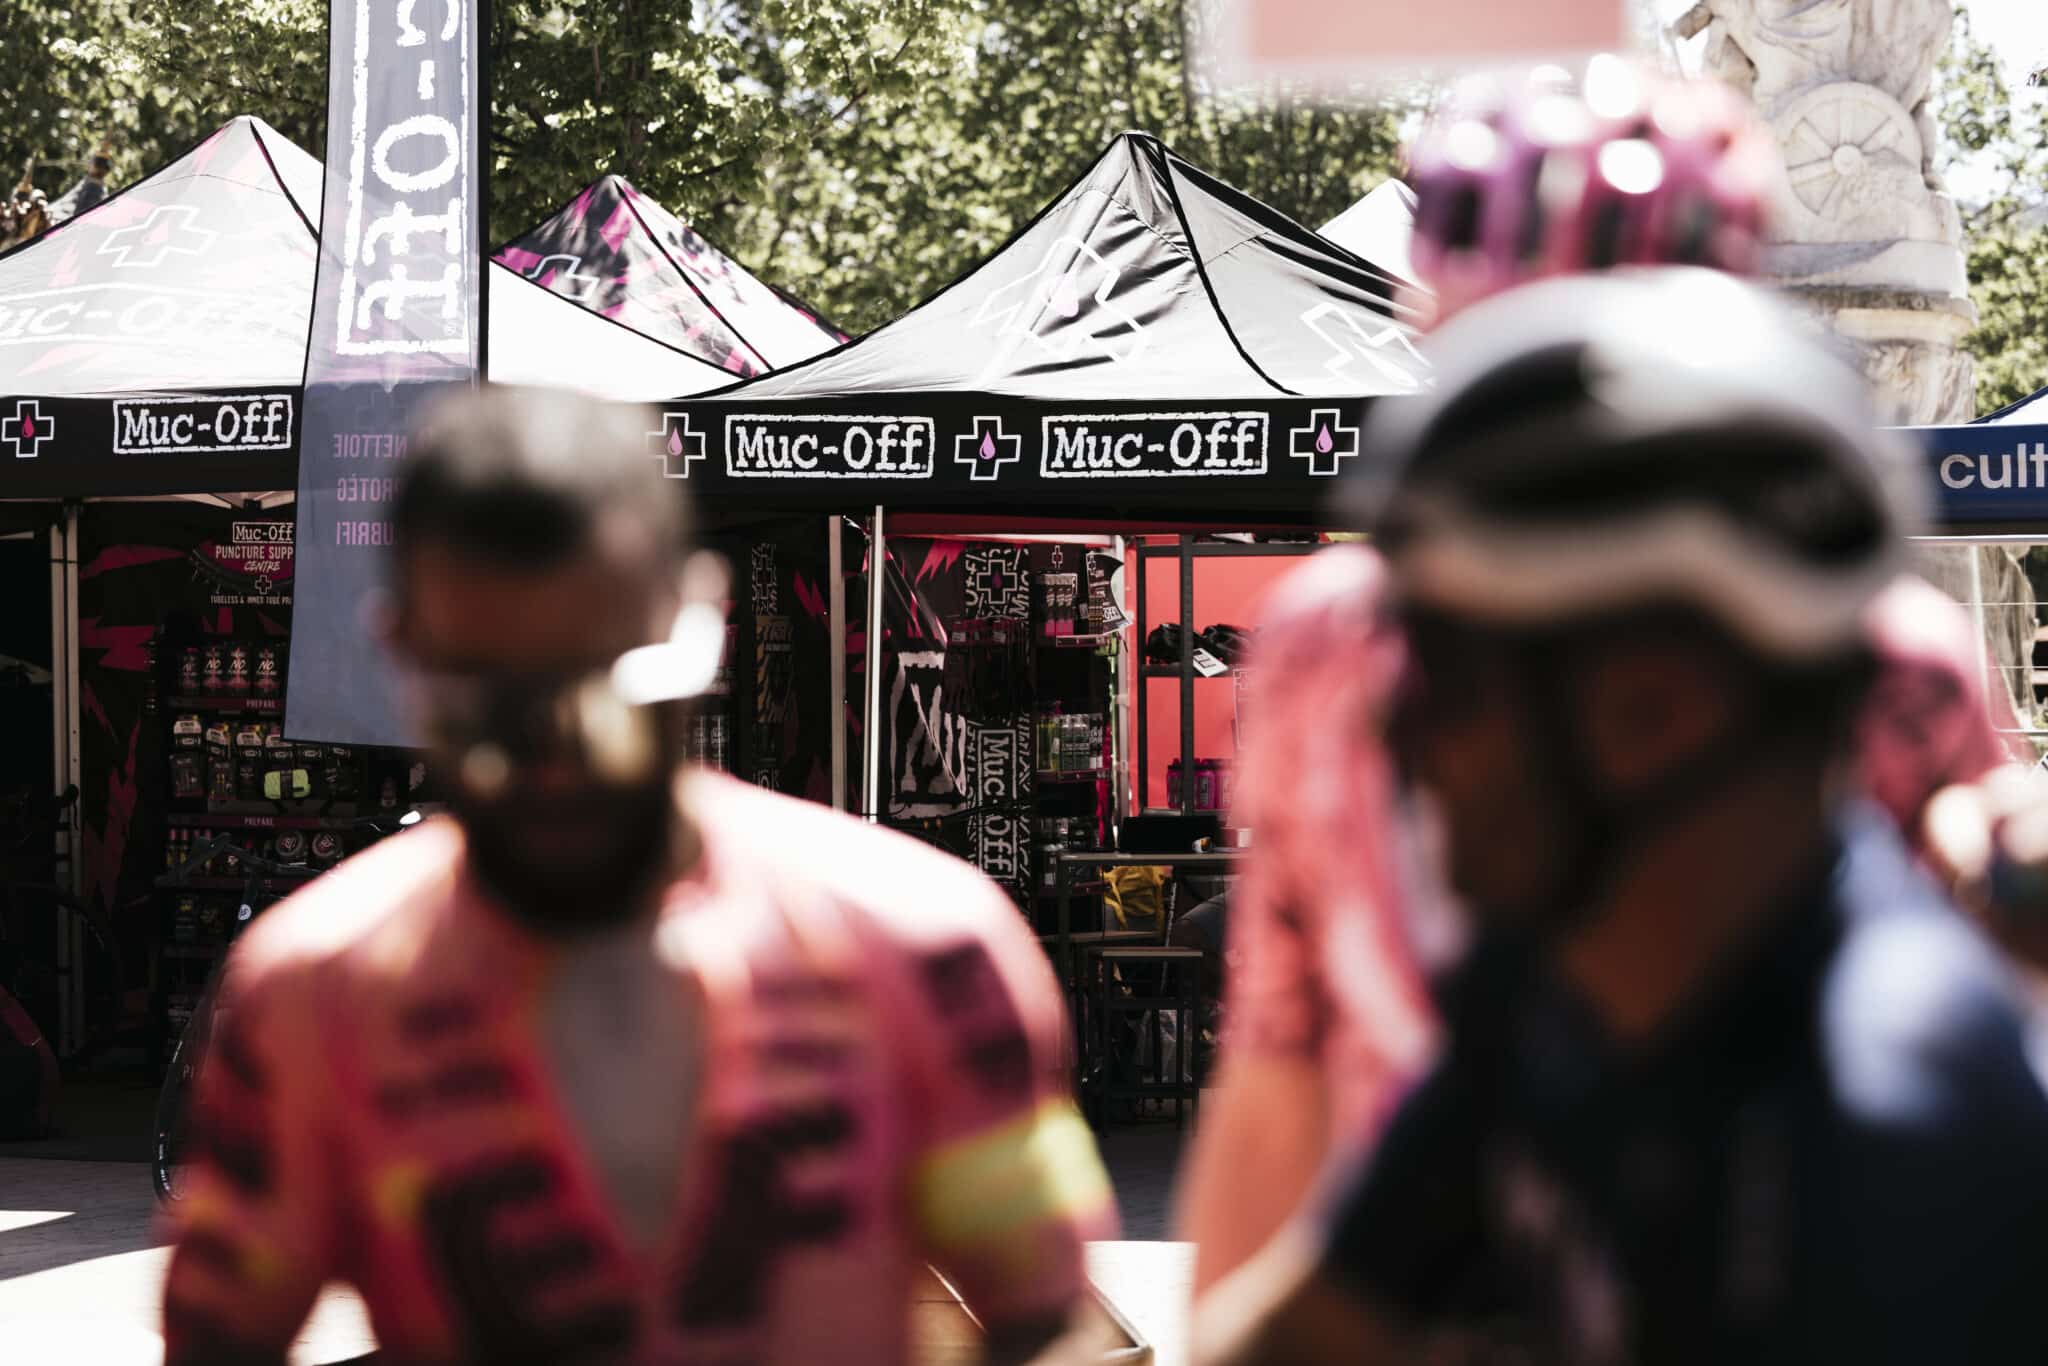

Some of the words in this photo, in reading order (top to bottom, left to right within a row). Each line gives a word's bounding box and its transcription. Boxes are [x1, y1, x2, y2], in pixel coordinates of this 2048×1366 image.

[121, 401, 284, 446] Muc-Off
[1051, 420, 1258, 468] Muc-Off
[735, 424, 925, 471] Muc-Off
[1940, 443, 2048, 489] cult
[215, 545, 265, 560] PUNCTURE
[235, 525, 293, 541] Muc-Off
[243, 561, 281, 573] CENTRE
